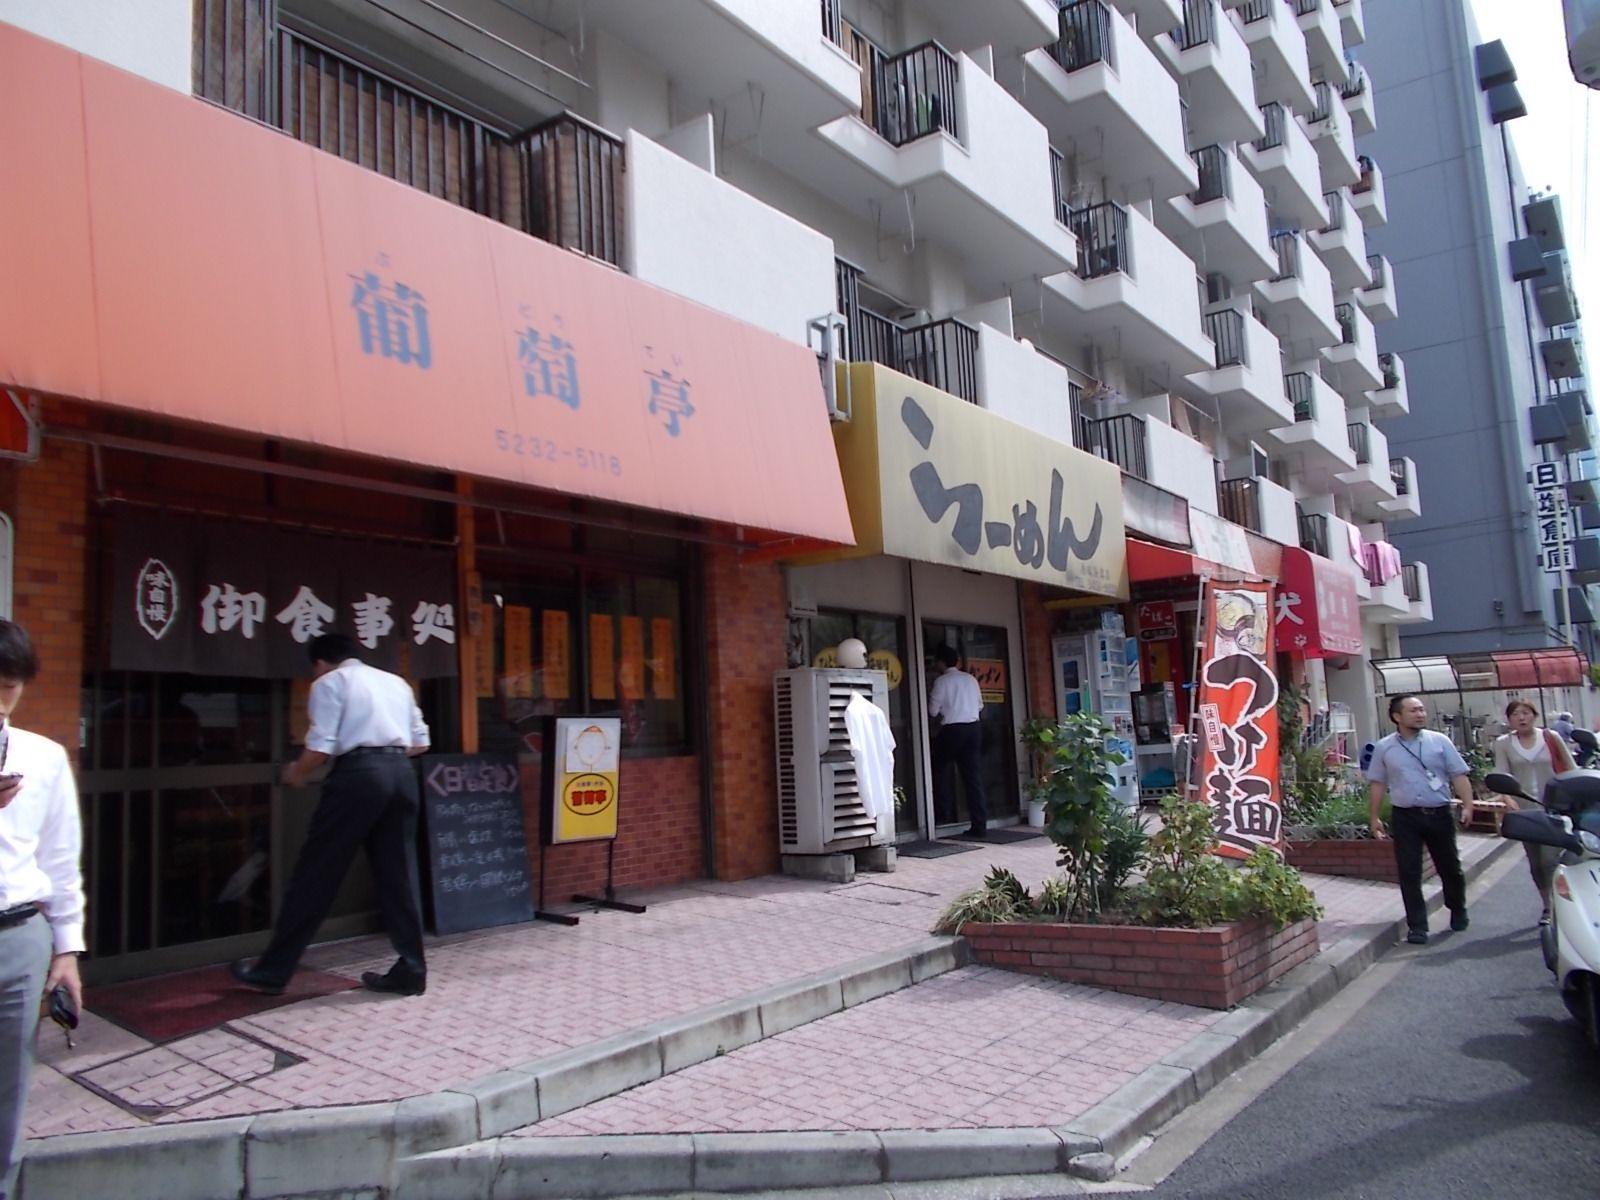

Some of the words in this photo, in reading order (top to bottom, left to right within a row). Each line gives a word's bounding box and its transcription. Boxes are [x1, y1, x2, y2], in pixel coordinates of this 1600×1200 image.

[347, 271, 696, 438] 葡萄亭
[494, 429, 623, 477] 5232-5118
[900, 396, 1103, 572] らーめん
[144, 569, 171, 623] 味自慢
[200, 582, 456, 650] 御食事処
[1140, 604, 1174, 626] たばこ
[1203, 652, 1283, 858] つけ麺
